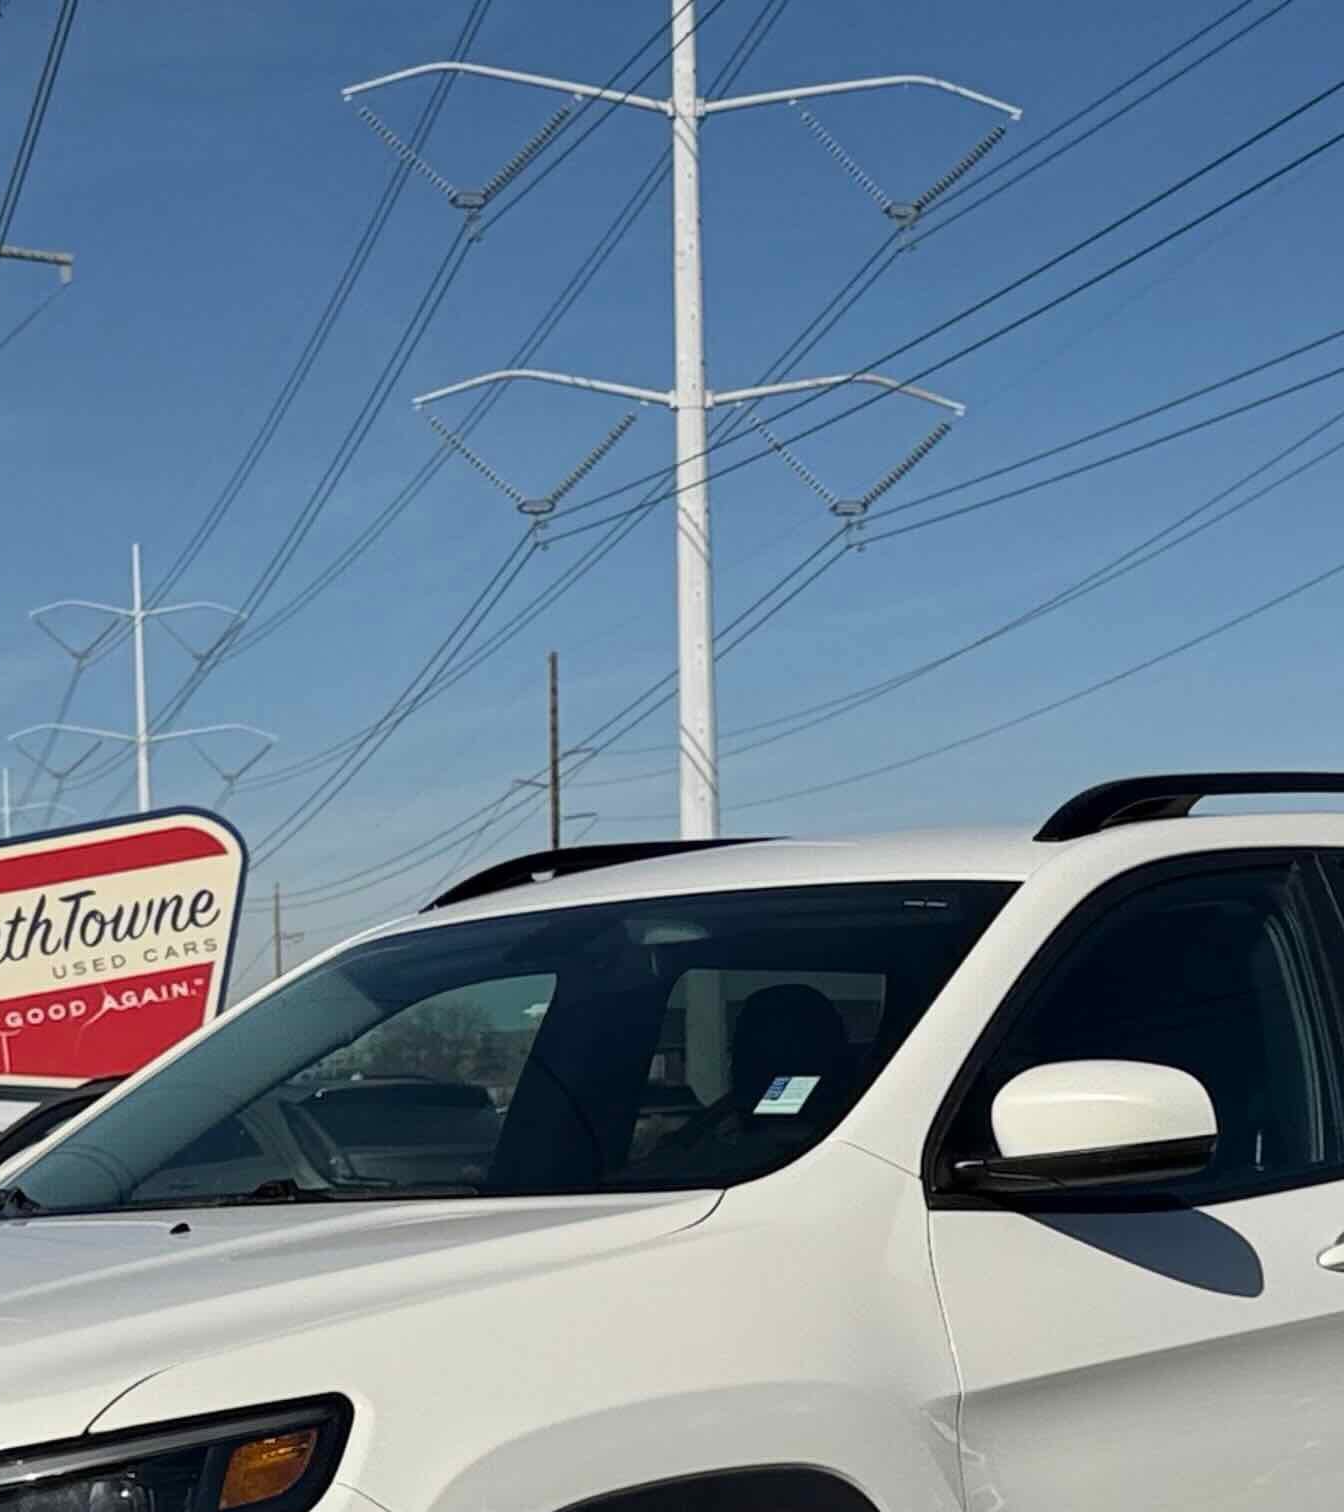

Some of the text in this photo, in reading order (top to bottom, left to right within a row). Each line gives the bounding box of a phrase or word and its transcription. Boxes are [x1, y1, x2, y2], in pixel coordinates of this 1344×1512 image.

[52, 938, 218, 980] USED CARS
[6, 1000, 87, 1028] GOOD
